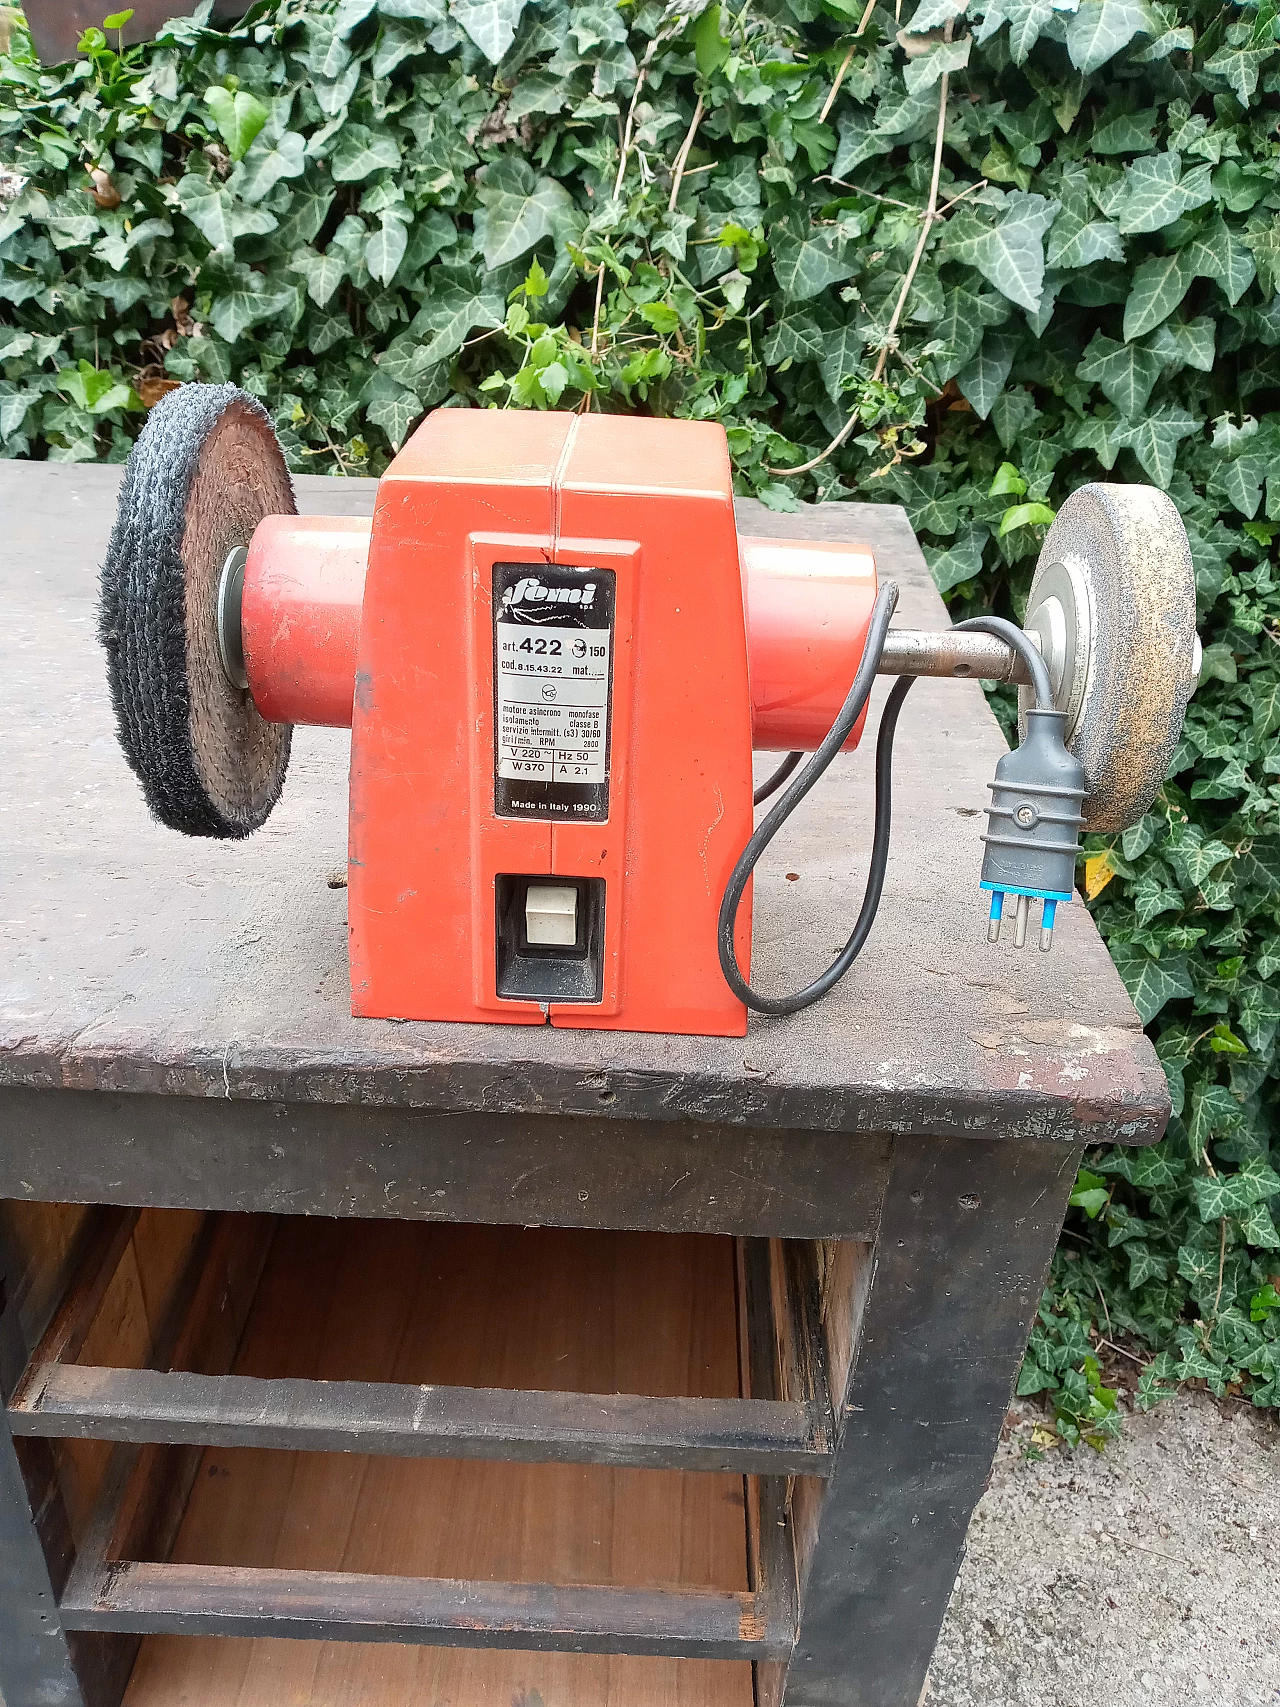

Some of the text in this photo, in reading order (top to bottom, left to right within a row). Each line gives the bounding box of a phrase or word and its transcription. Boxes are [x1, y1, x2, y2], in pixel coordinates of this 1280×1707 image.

[508, 578, 597, 605] femi
[589, 646, 606, 657] 150
[502, 705, 600, 719] motore asincrono monofase
[502, 714, 599, 729] isolamento classe B
[502, 725, 529, 735] servizio
[581, 729, 601, 738] 30/60
[539, 737, 555, 747] RPM
[583, 740, 599, 748] 2800
[510, 748, 518, 757] V
[521, 749, 541, 758] 220
[558, 752, 589, 761] Hz 50
[524, 762, 545, 772] 370
[559, 765, 588, 775] A 2.1
[511, 800, 597, 812] Made in Italy 1990
